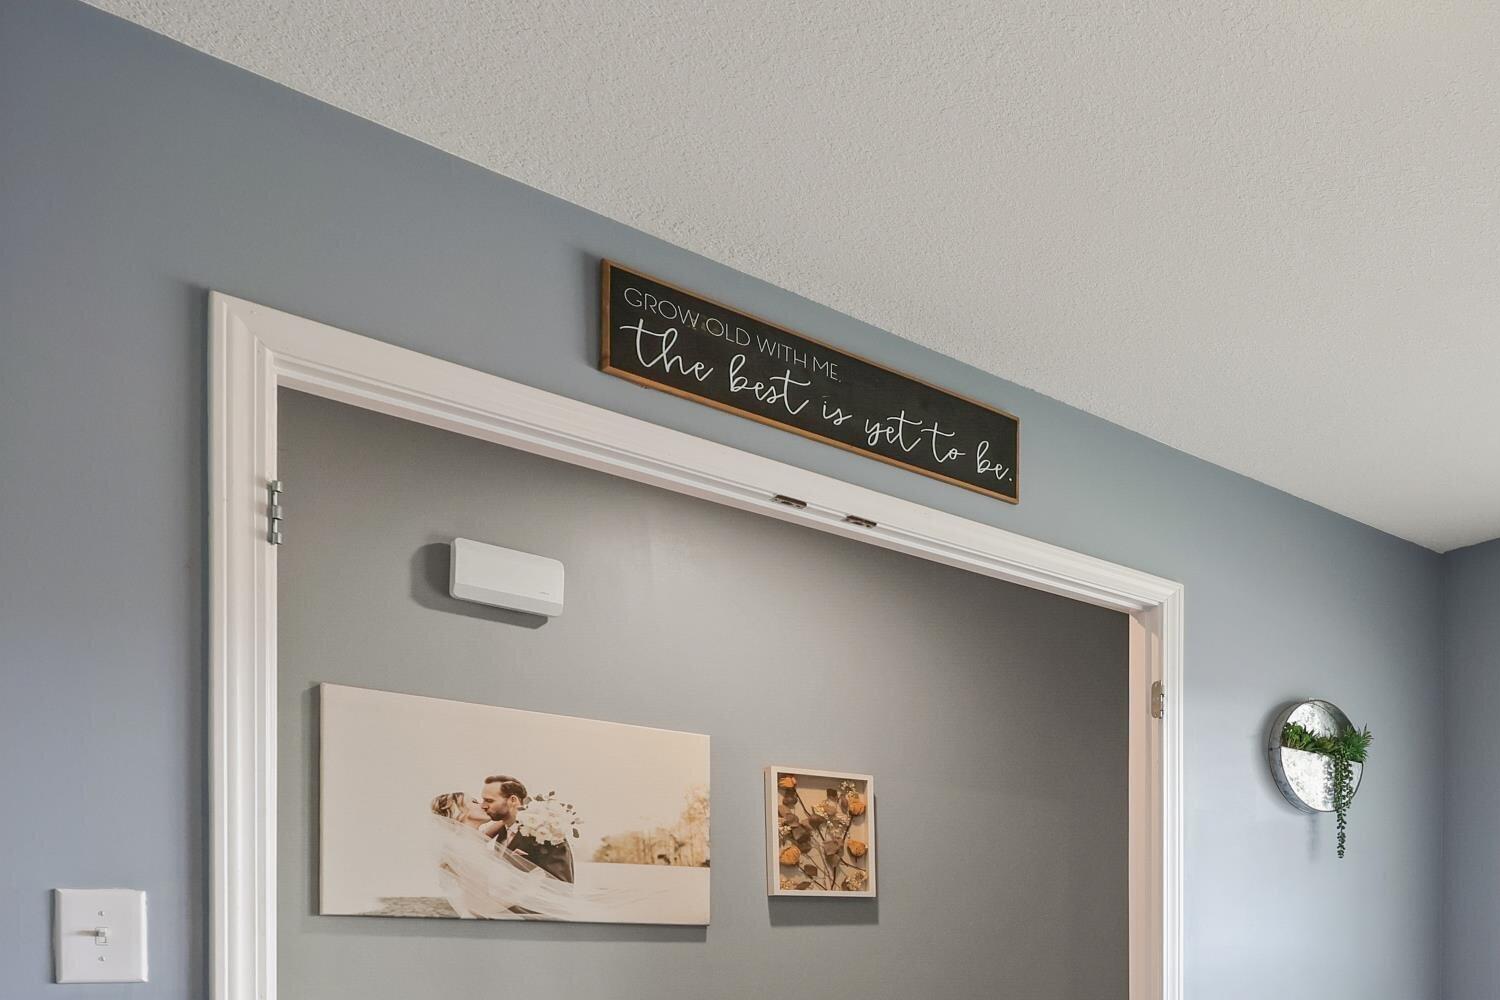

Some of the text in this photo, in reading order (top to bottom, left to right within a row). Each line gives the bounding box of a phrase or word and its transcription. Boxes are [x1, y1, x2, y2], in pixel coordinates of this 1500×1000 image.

[619, 318, 1014, 482] the best is yet to be.
[624, 287, 842, 383] GROW OLD WITH ME.
